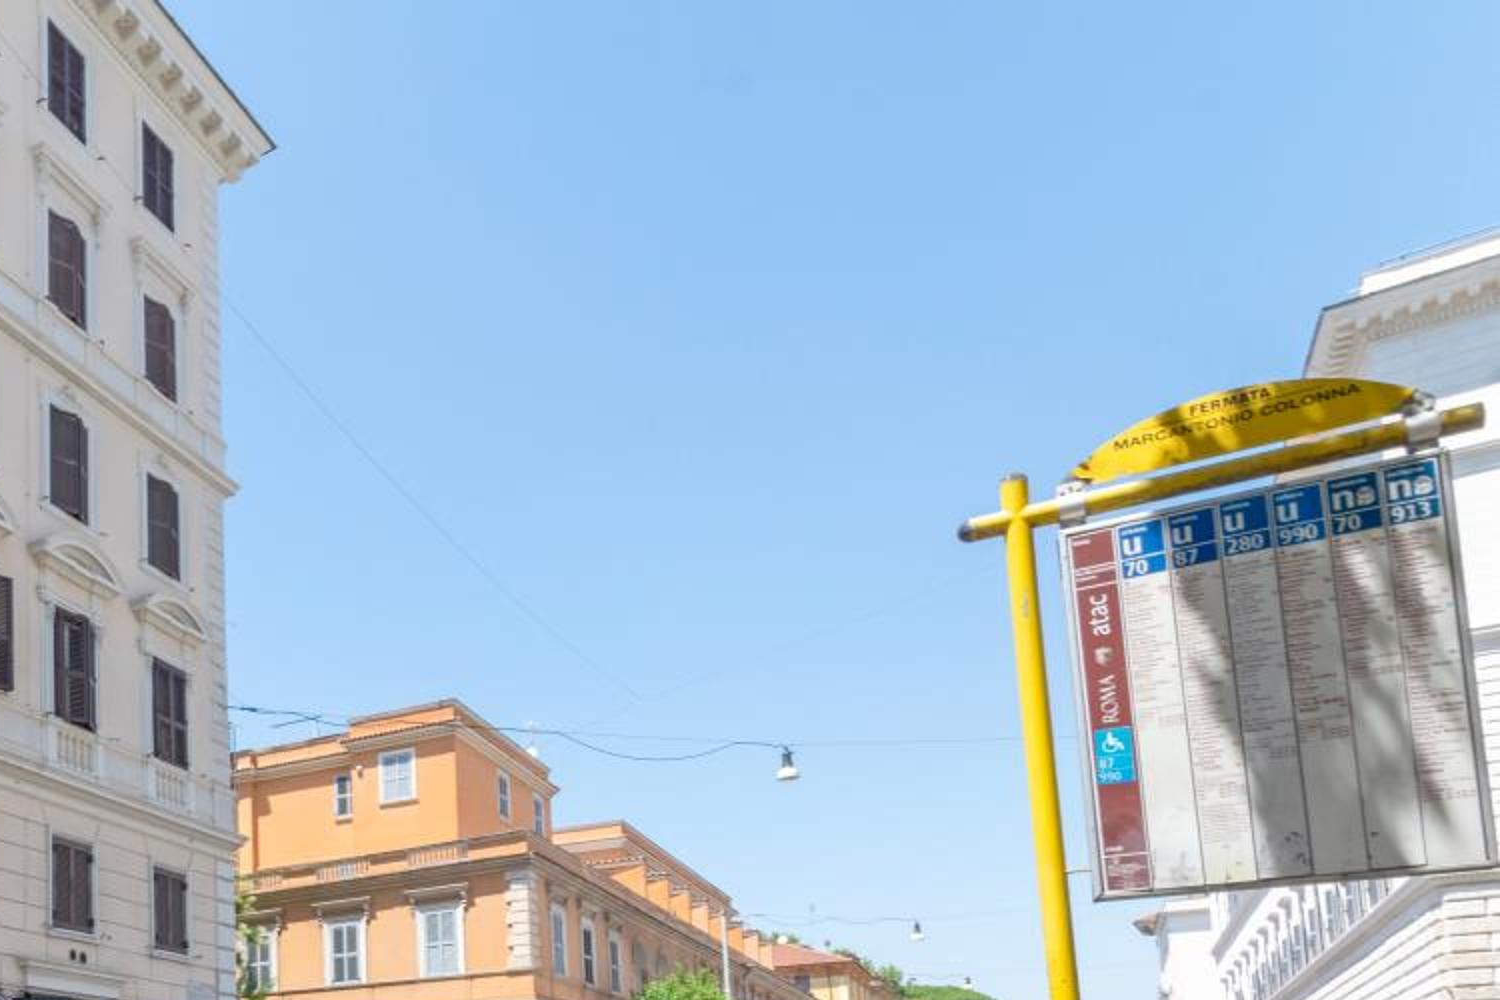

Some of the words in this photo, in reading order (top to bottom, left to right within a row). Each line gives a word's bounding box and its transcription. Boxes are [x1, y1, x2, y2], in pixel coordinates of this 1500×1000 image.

[1189, 386, 1271, 417] FERMATA
[1113, 409, 1252, 450] MARCANTONIO
[1261, 384, 1361, 416] COLONNA
[1392, 501, 1432, 523] 913
[1280, 523, 1318, 545] 990
[1336, 514, 1362, 534] 70
[1227, 533, 1265, 555] 280
[1123, 560, 1148, 577] 70
[1174, 548, 1199, 567] 87
[1088, 593, 1112, 637] atac
[1098, 675, 1121, 724] ROMA
